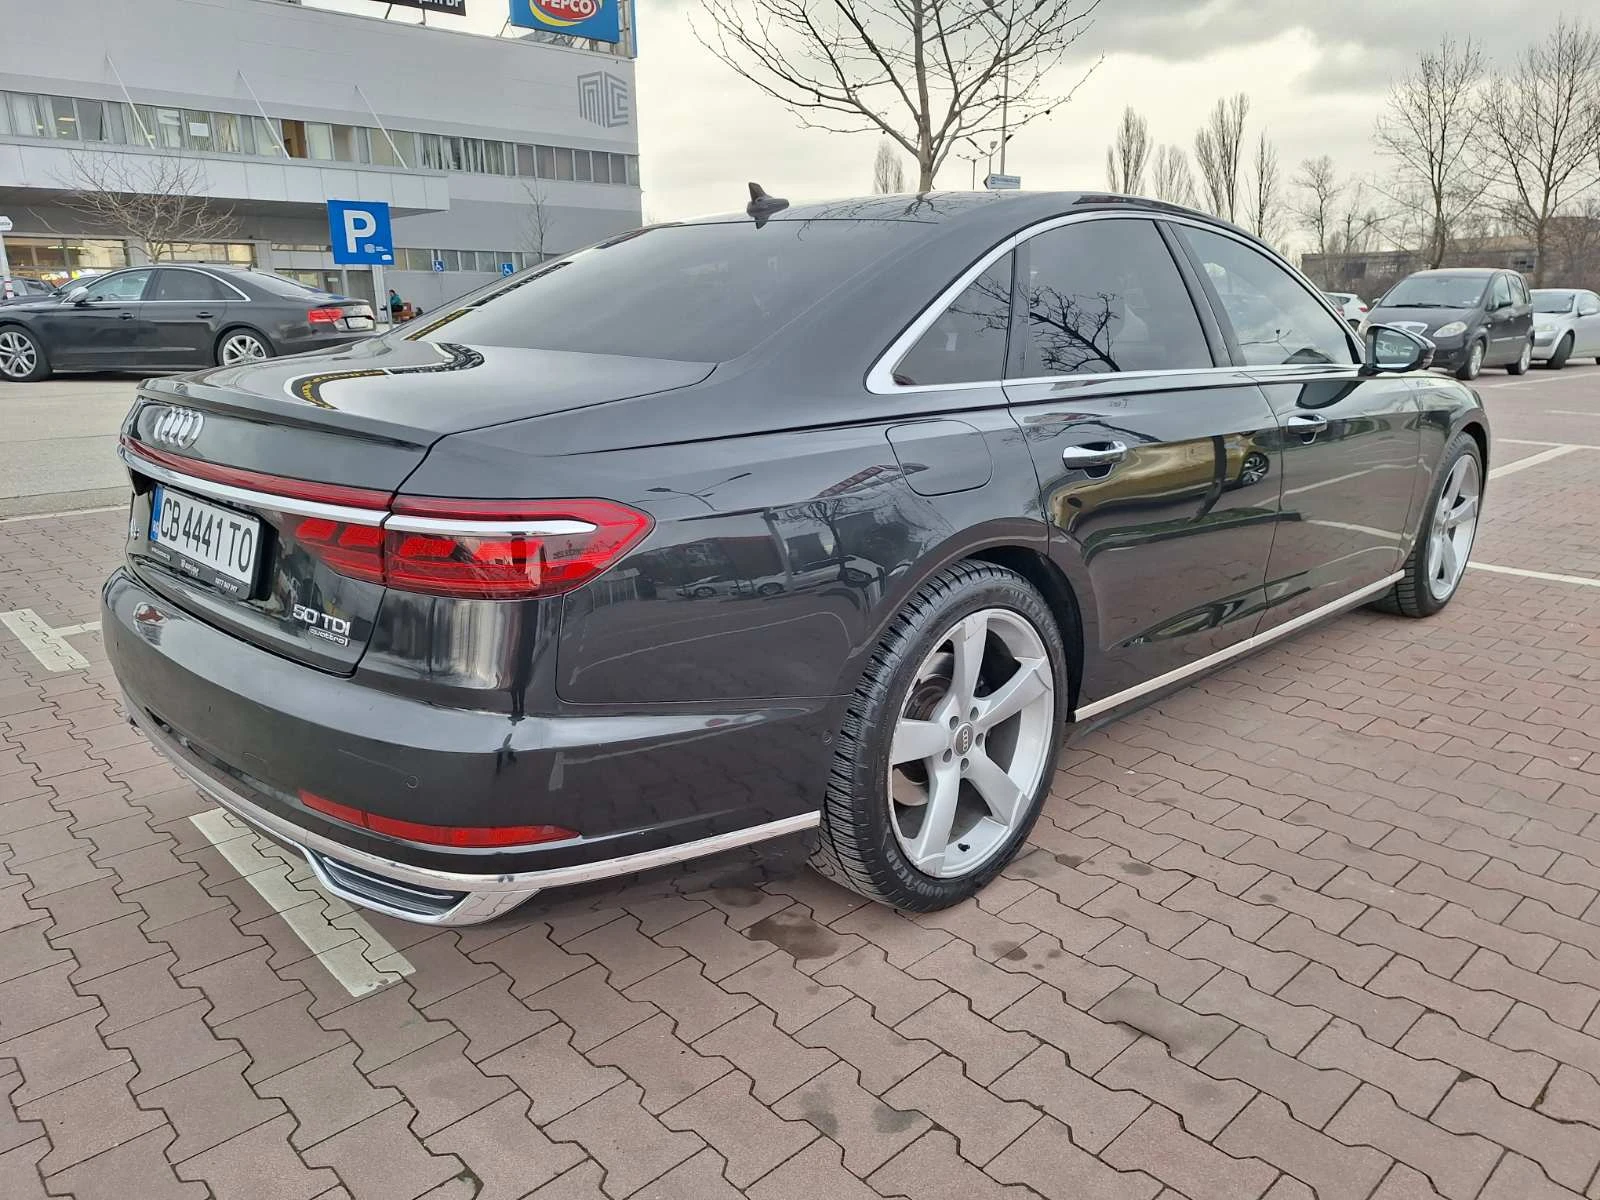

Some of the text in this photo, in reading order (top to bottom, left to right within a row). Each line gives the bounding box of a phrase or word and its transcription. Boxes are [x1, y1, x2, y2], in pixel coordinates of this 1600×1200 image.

[343, 209, 377, 253] P
[160, 497, 253, 573] CB 4441 TO
[292, 603, 351, 636] 50 TDI
[309, 627, 345, 645] quattro
